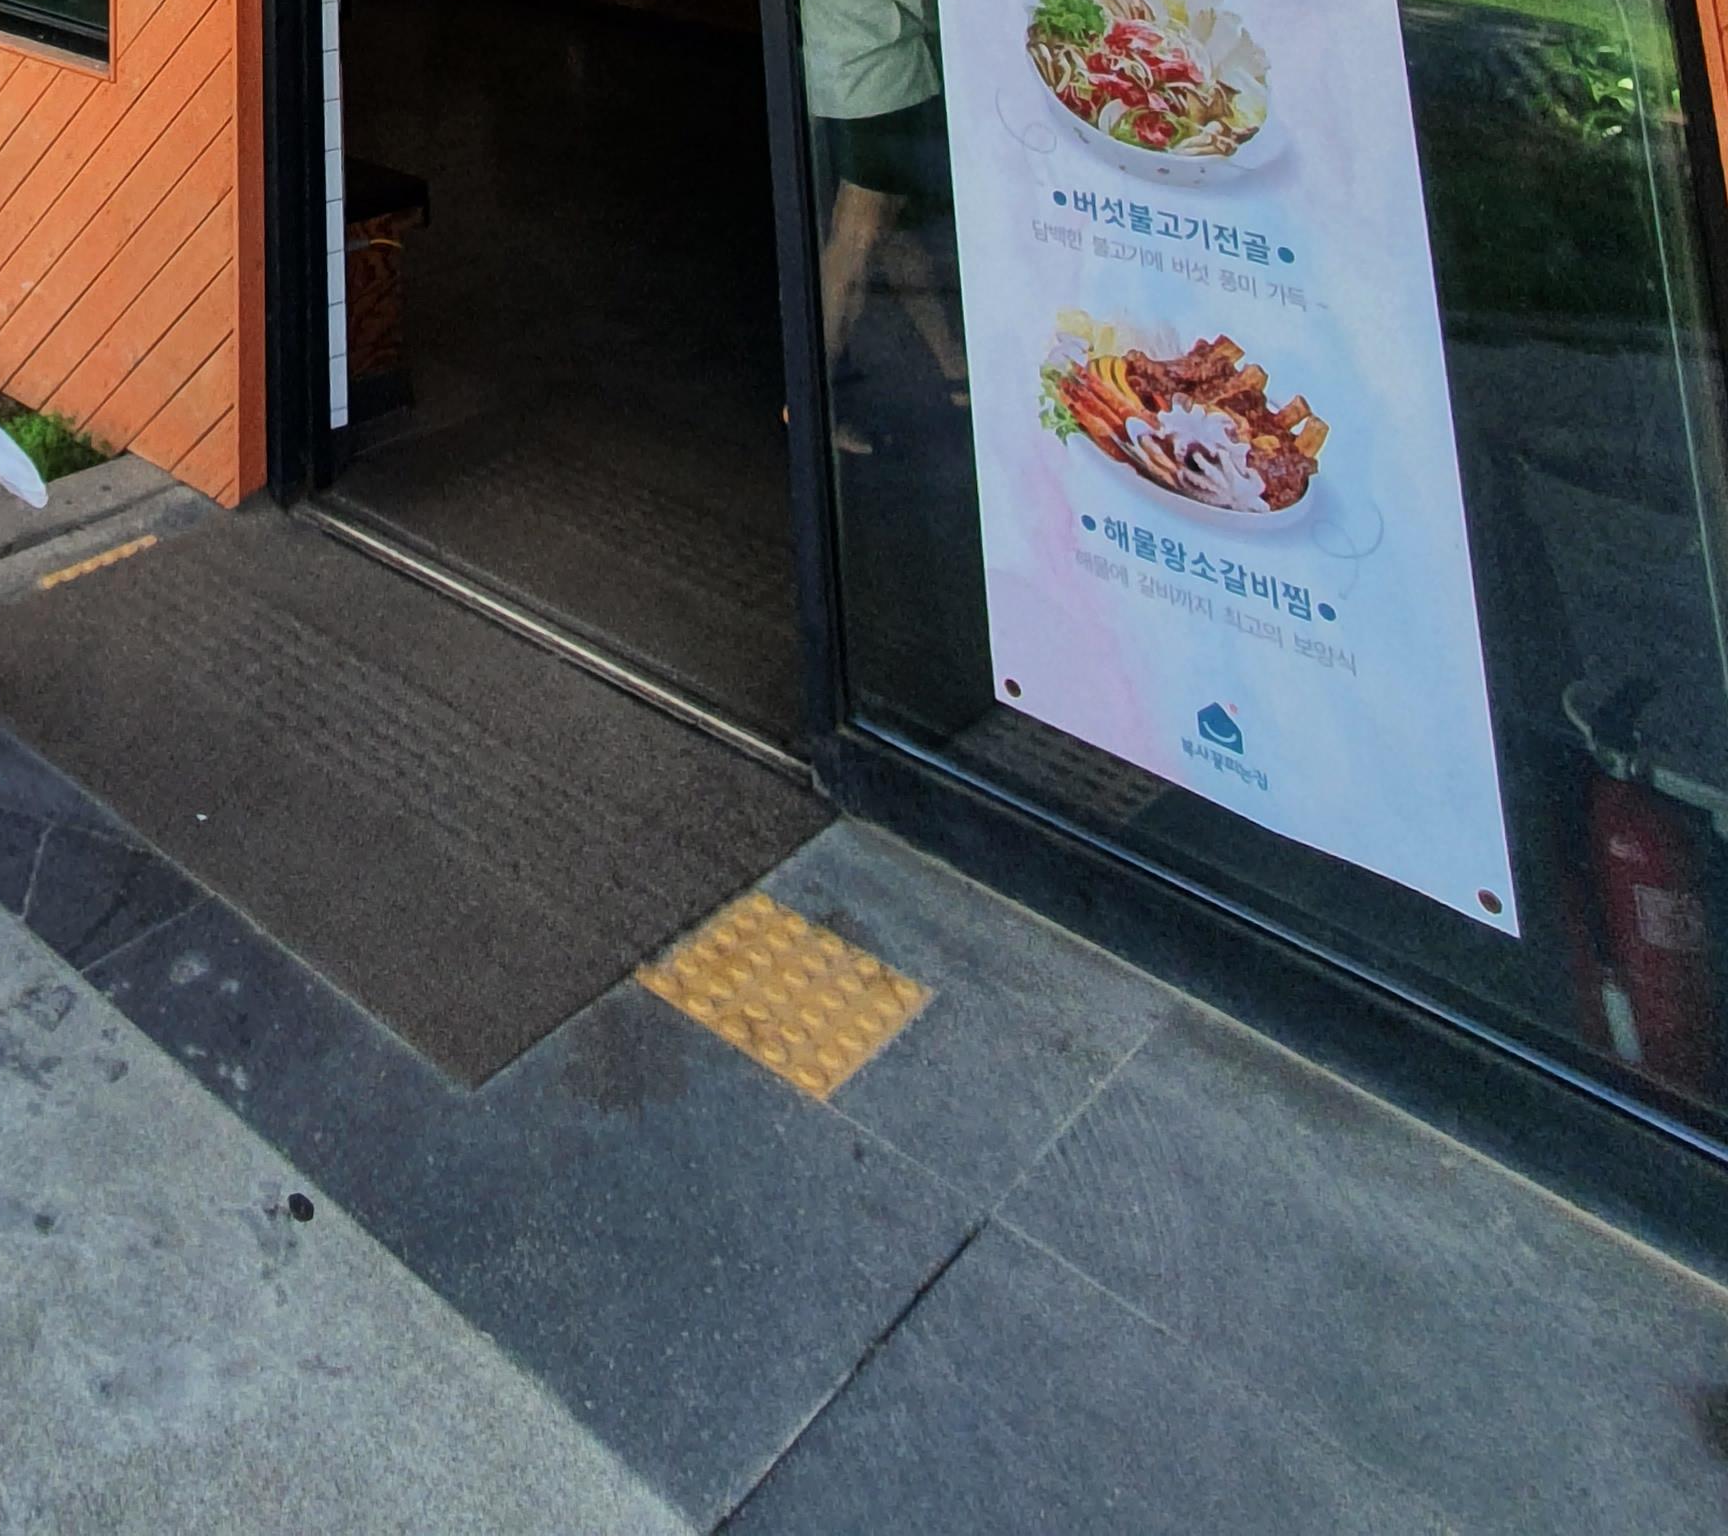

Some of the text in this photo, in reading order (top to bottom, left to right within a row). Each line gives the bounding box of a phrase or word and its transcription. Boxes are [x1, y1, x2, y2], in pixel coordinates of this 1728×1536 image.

[1071, 190, 1271, 266] 버섯불고기전골
[1092, 235, 1164, 273] 불고기에
[1172, 255, 1211, 287] 버섯
[1103, 515, 1313, 622] 해물왕소갈비찜
